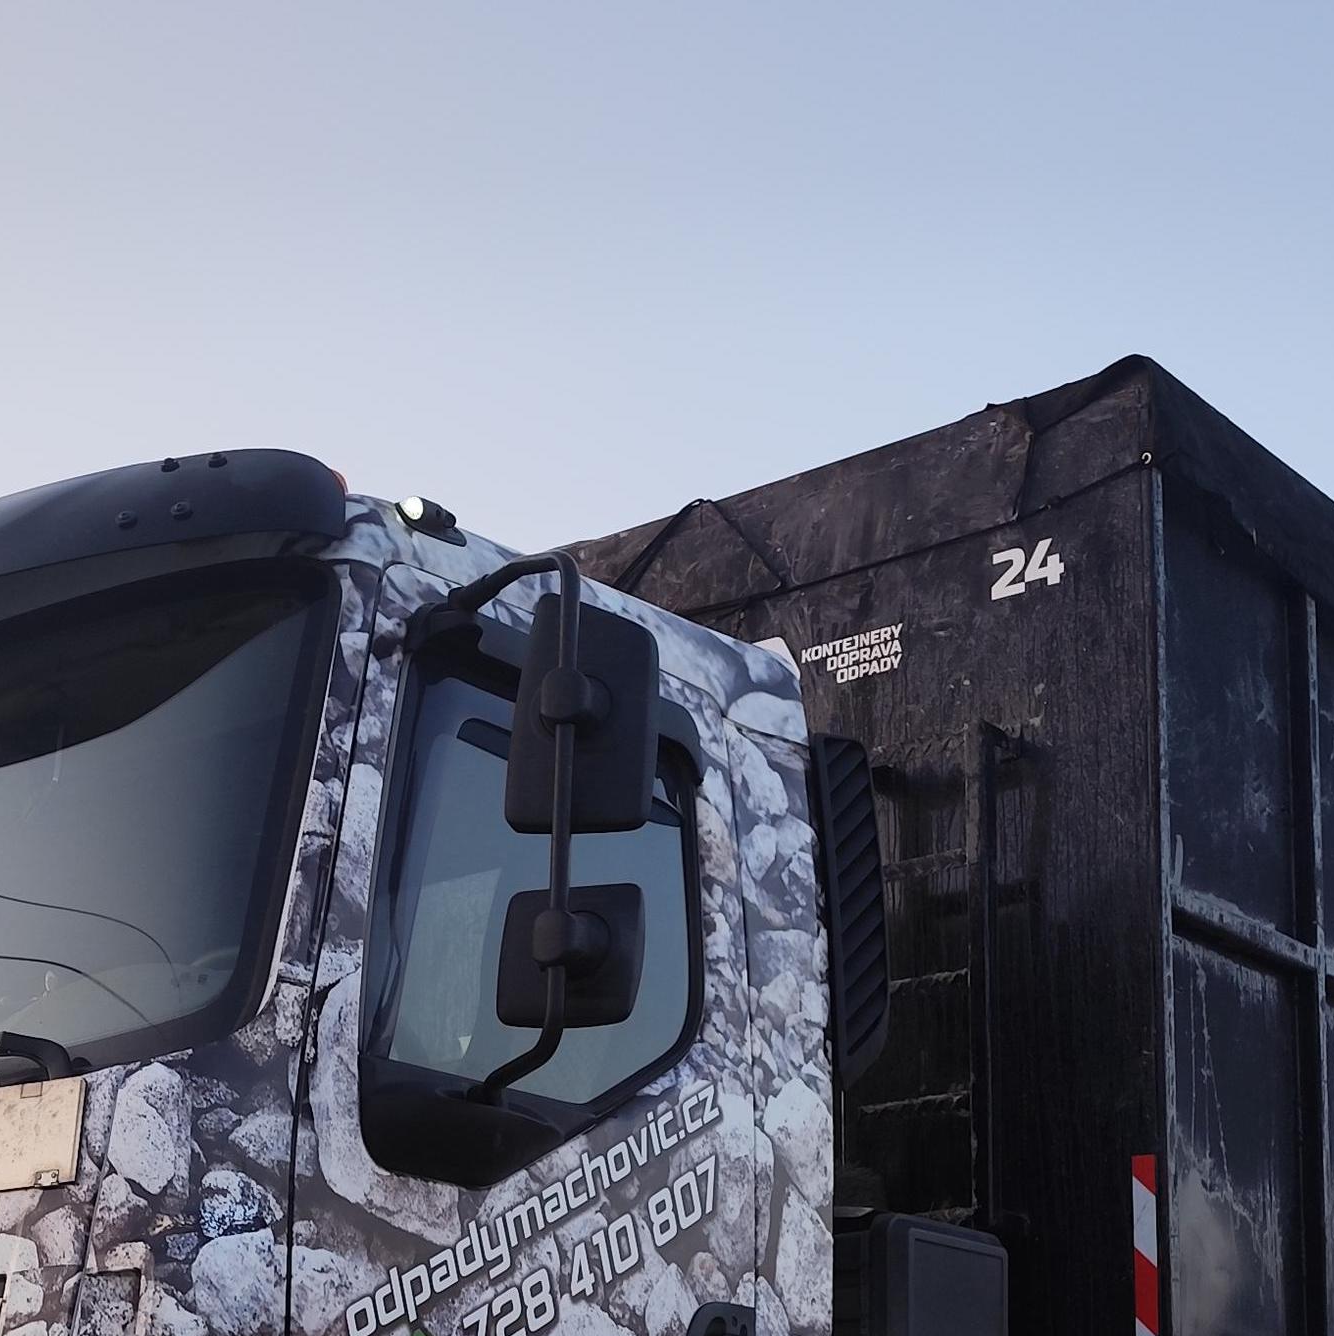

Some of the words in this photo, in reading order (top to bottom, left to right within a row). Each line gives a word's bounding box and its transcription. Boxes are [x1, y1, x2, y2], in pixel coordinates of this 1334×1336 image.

[990, 537, 1065, 601] 24
[801, 623, 903, 664] KONTEJNERY
[826, 639, 903, 672] DOPRAVA
[836, 653, 903, 685] ODPADY
[570, 1213, 640, 1298] 410
[648, 1155, 717, 1248] 807
